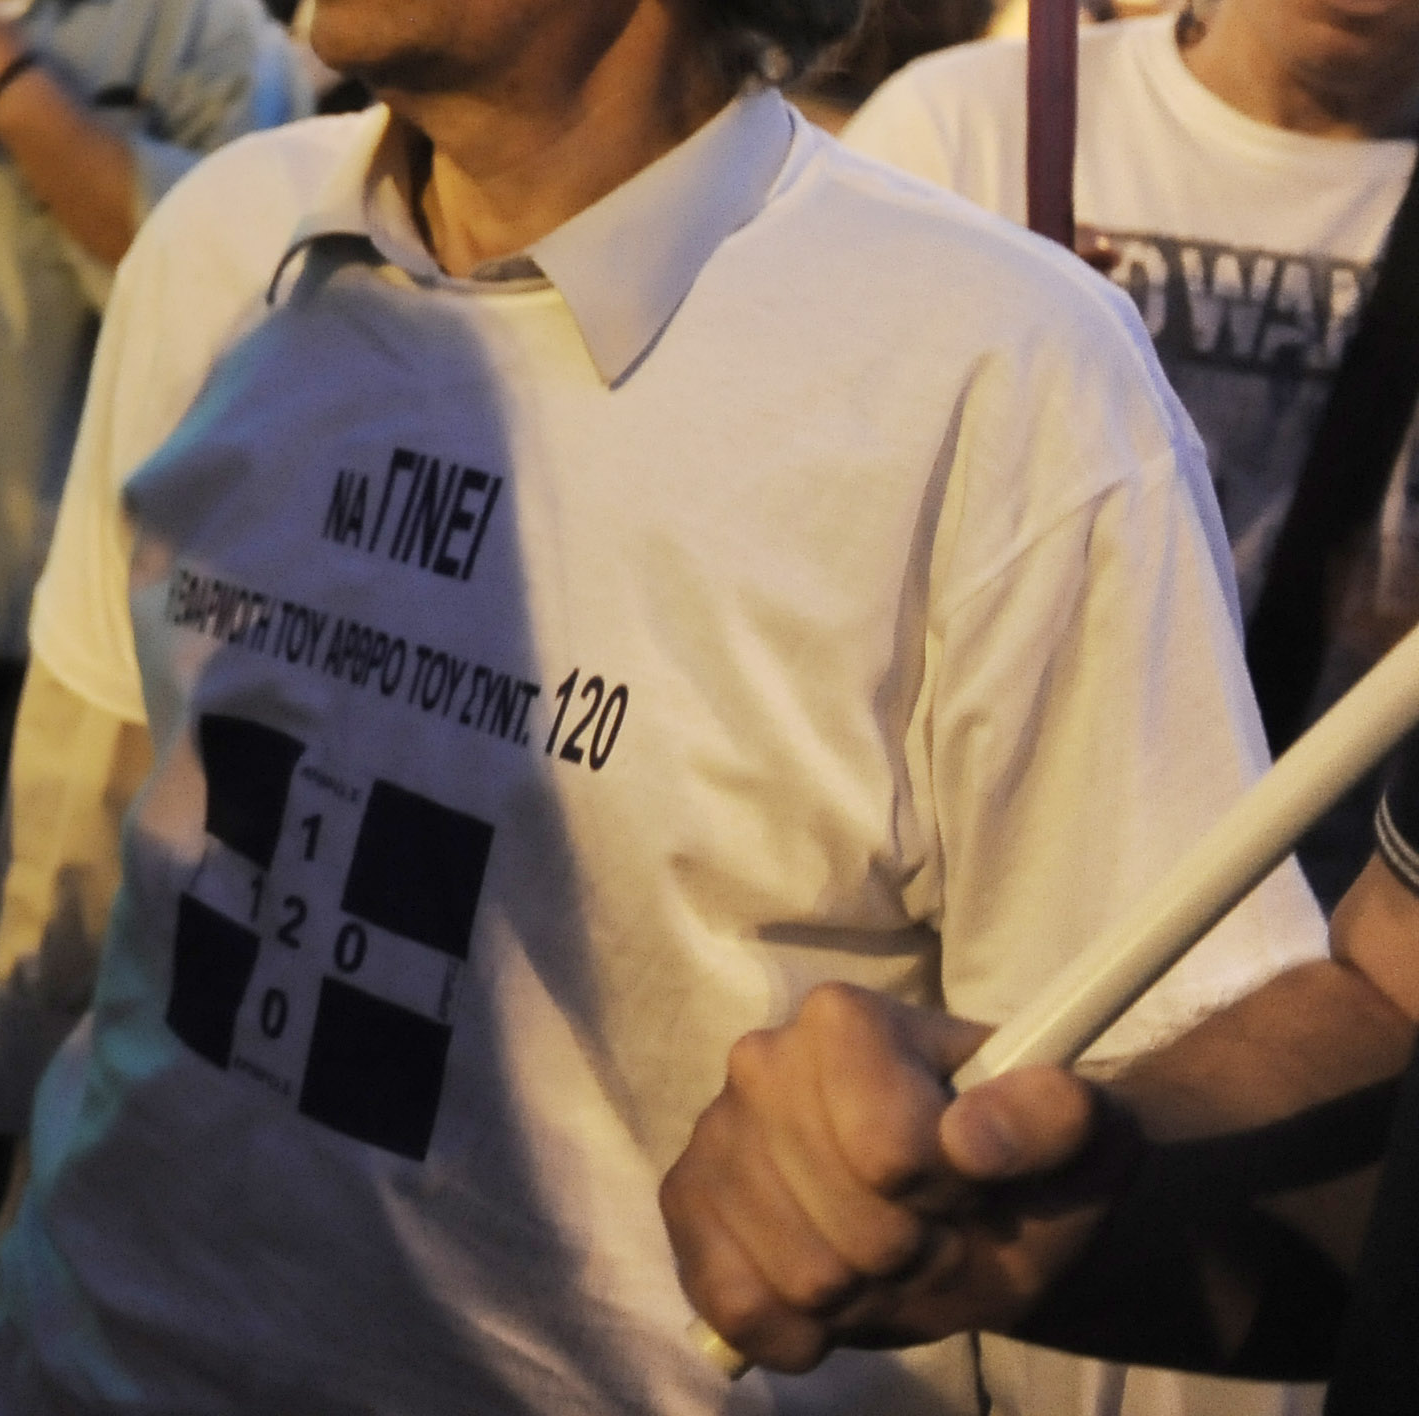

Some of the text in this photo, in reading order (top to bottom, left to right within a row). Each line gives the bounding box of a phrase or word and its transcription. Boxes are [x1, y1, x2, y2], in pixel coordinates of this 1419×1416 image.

[323, 447, 502, 581] ΝΑ ΓΙΝΕΙ
[272, 601, 327, 668] ΤΟΥ
[321, 618, 407, 697] ΑΡΘΡΟ
[408, 644, 468, 718] ΤΟΥ
[545, 667, 629, 772] 120
[301, 813, 323, 863] 1
[277, 894, 307, 950] 2
